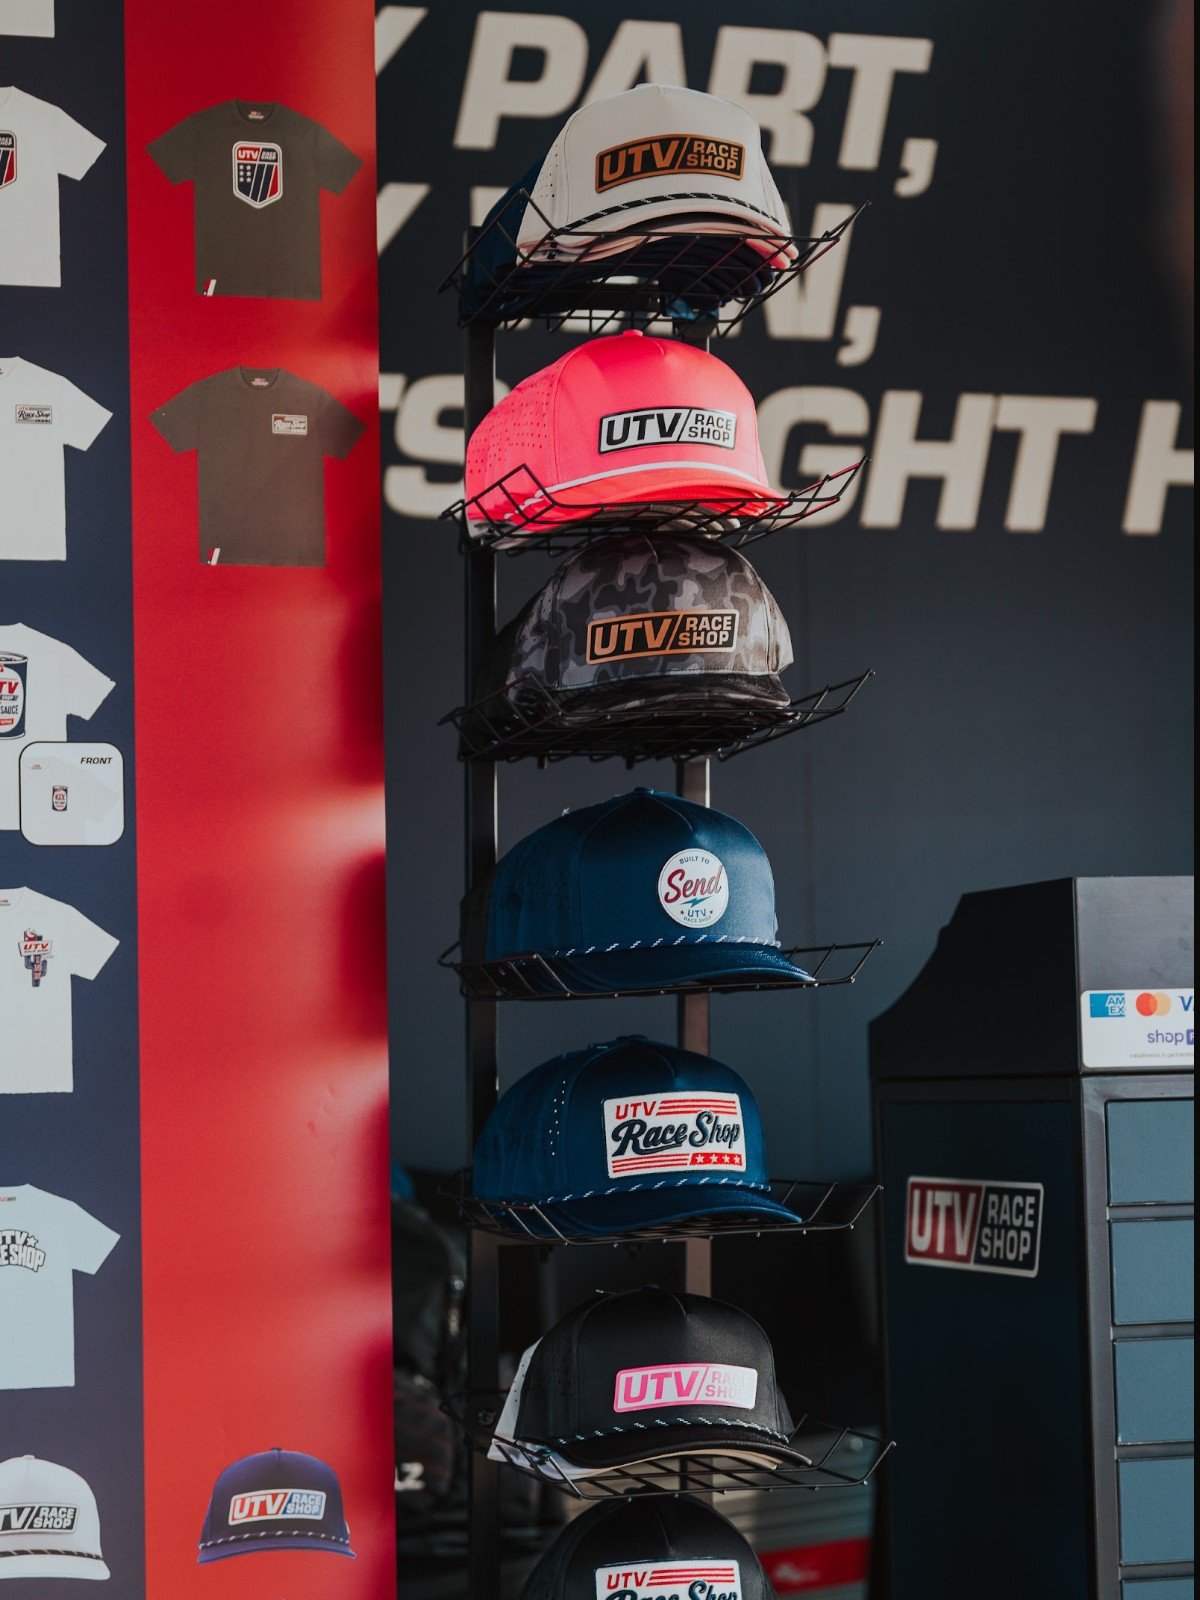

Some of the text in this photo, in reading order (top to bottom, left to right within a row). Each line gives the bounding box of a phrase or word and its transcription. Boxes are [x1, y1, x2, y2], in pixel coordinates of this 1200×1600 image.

[452, 11, 938, 197] PART,
[238, 149, 259, 159] UTV
[693, 141, 739, 160] RACE
[603, 140, 680, 182] UTV
[686, 153, 737, 171] SHOP
[606, 412, 682, 446] UTV
[694, 413, 733, 431] RACE
[688, 426, 730, 442] SHOP
[685, 615, 732, 631] RACE
[594, 618, 673, 656] UTV
[678, 630, 729, 646] SHOP
[1, 705, 18, 715] SAUCE
[80, 757, 113, 765] FRONT
[679, 856, 710, 865] BUILT TO
[664, 864, 723, 904] Send
[687, 908, 707, 918] UTV
[1147, 1029, 1184, 1046] shop
[615, 1101, 657, 1120] UTV
[611, 1110, 740, 1157] Race Shop
[987, 1194, 1035, 1228] RACE
[911, 1189, 976, 1256] UTV
[9, 1243, 45, 1272] SHOP
[980, 1227, 1031, 1272] SHOP
[624, 1371, 699, 1403] UTV
[233, 1492, 286, 1519] UTV
[291, 1492, 321, 1505] RACE
[39, 1507, 75, 1518] RACE
[286, 1503, 319, 1514] SHOP
[33, 1517, 72, 1529] SHOP
[606, 1571, 648, 1590] UTV
